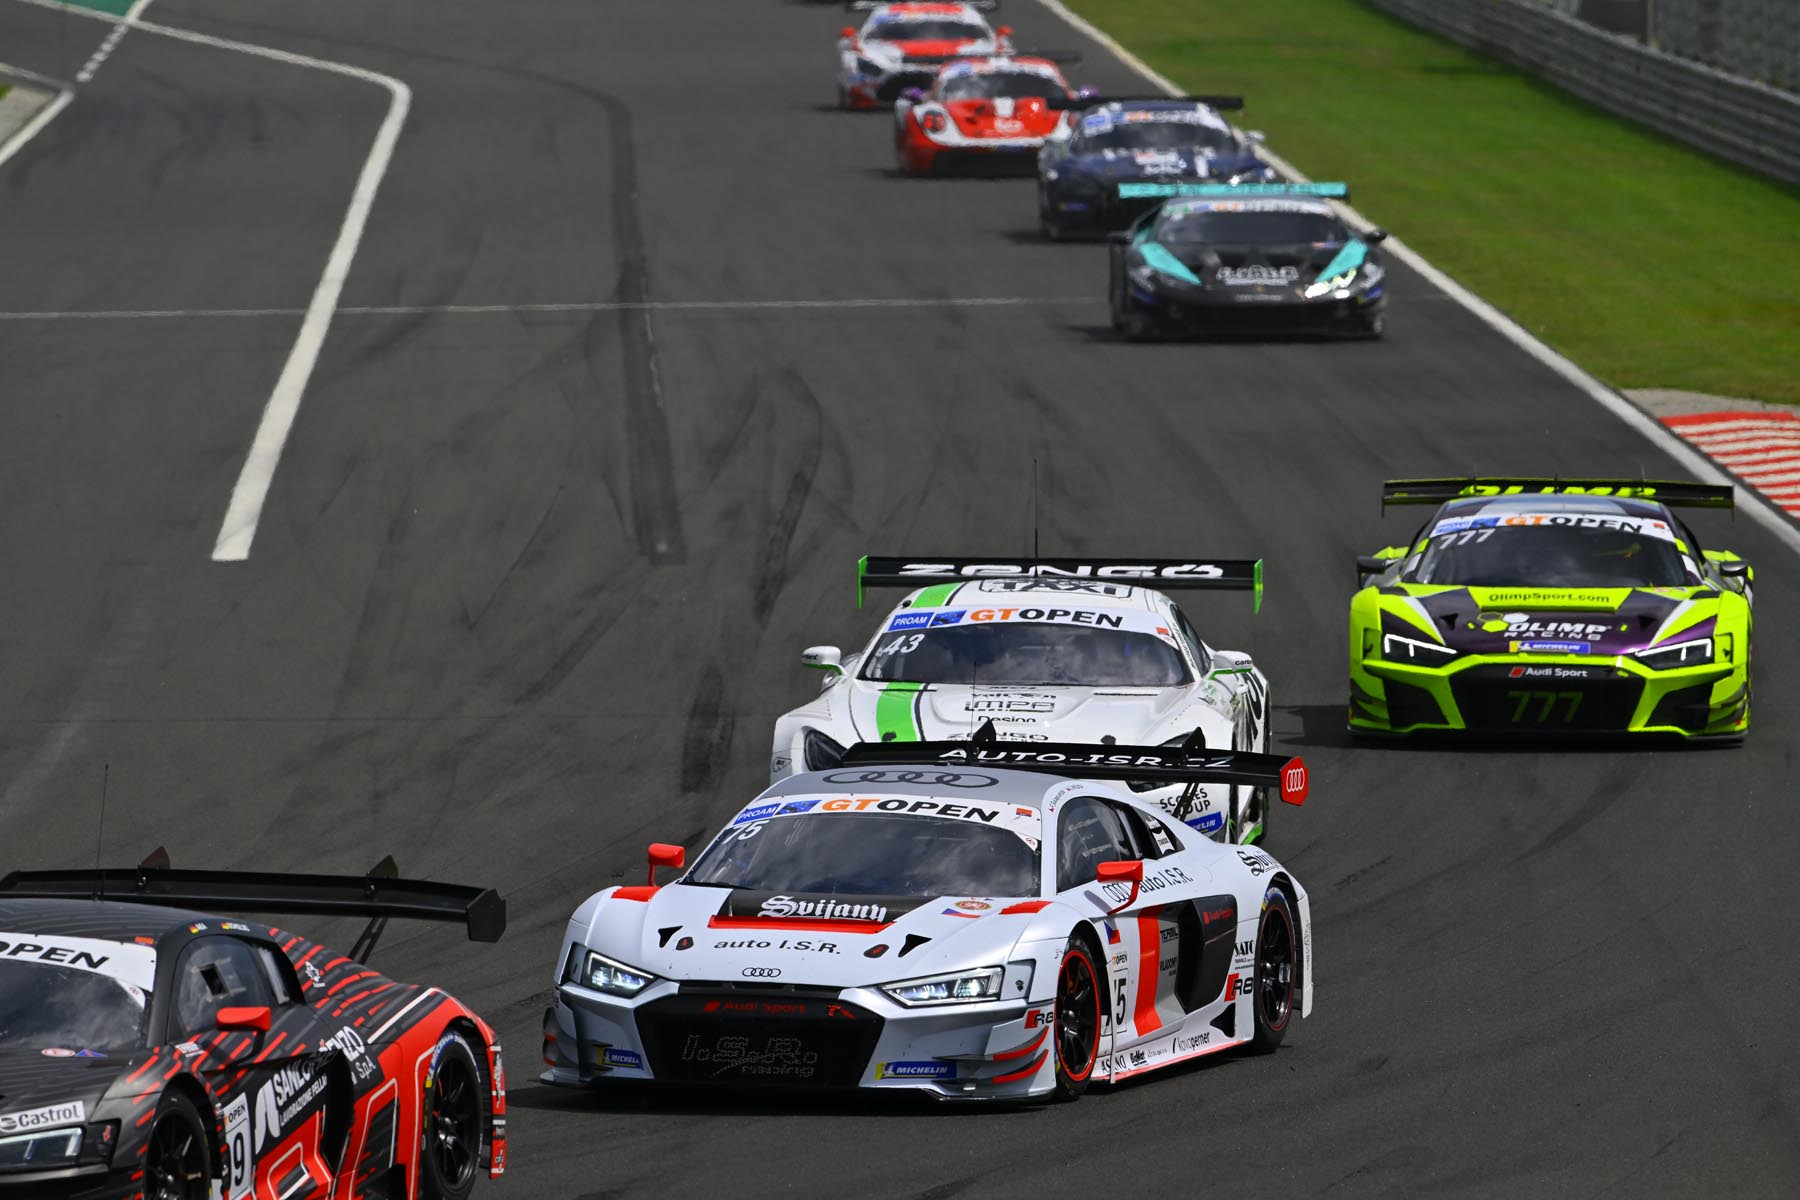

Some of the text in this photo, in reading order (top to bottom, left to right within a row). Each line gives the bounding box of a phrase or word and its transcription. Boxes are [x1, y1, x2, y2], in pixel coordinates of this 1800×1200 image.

[1440, 528, 1496, 550] 777
[893, 614, 929, 628] PROAM
[1507, 622, 1608, 634] OLIMP
[1504, 632, 1602, 641] RACING
[882, 634, 926, 656] 43
[1525, 667, 1588, 678] Audi Sport
[1508, 690, 1583, 723] 777
[737, 805, 777, 821] PROAM
[724, 819, 770, 844] 75
[757, 895, 888, 922] Svijany
[714, 938, 841, 954] auto I.S.R.
[1230, 977, 1254, 997] R8
[1032, 1011, 1054, 1025] R8
[896, 1066, 948, 1075] MICHELIN
[18, 1104, 81, 1128] Castrol
